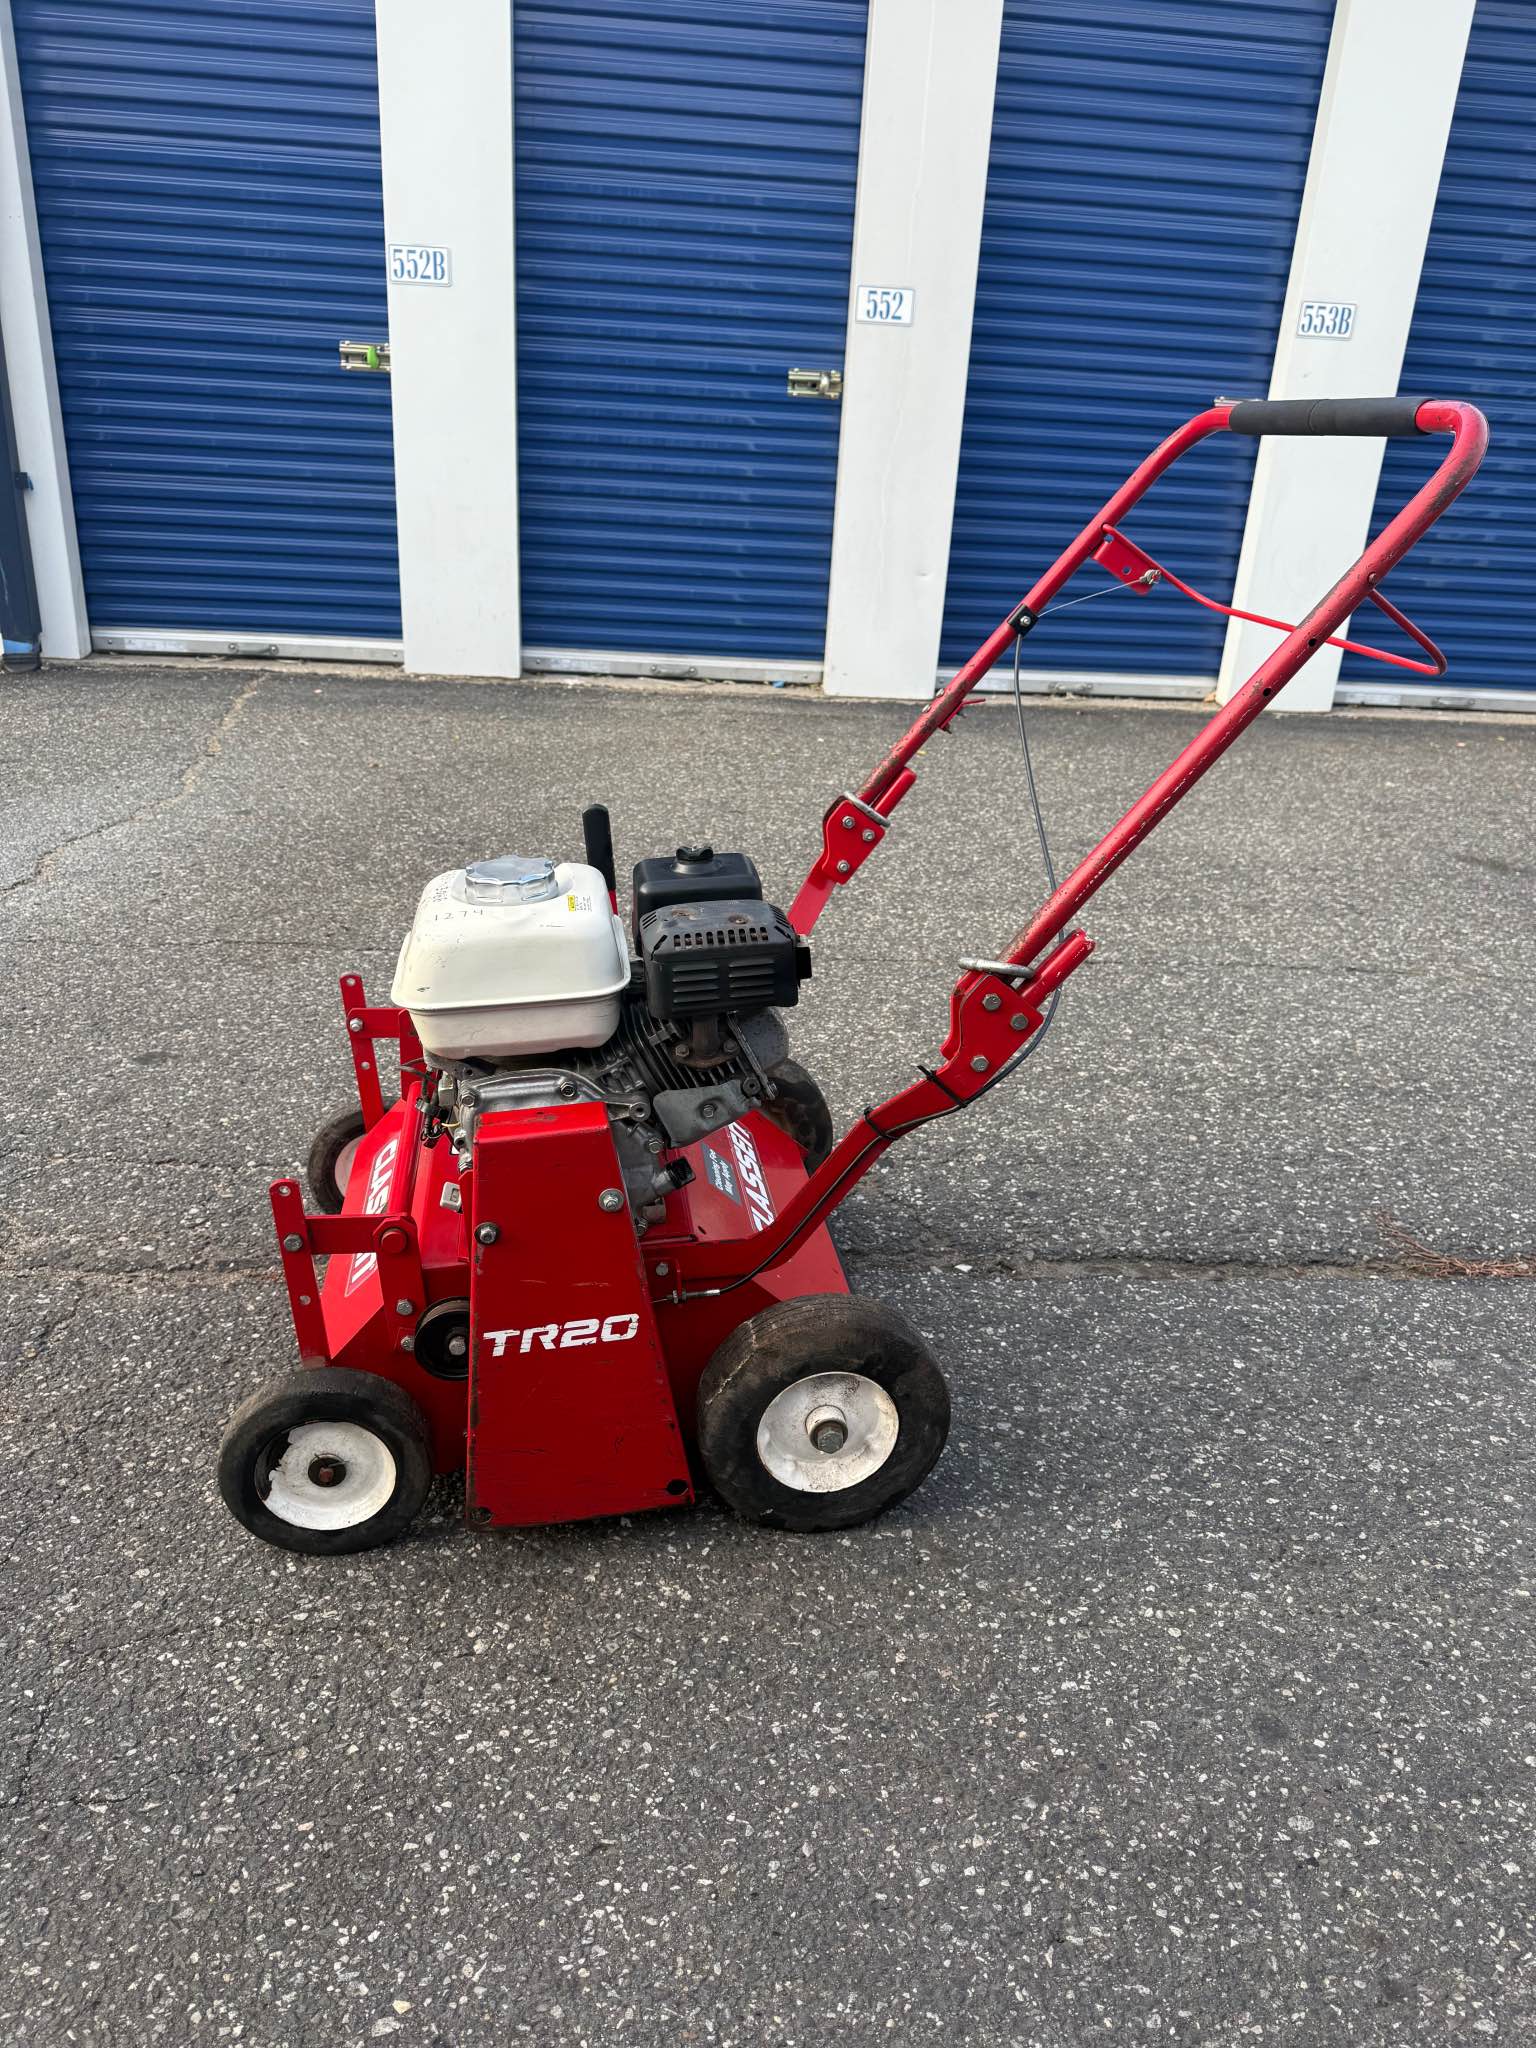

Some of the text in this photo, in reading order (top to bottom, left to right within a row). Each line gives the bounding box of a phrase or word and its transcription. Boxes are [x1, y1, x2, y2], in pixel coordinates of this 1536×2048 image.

[393, 248, 446, 281] 552B
[866, 290, 904, 321] 552
[1301, 305, 1352, 335] 553B
[483, 1313, 640, 1357] TR20
